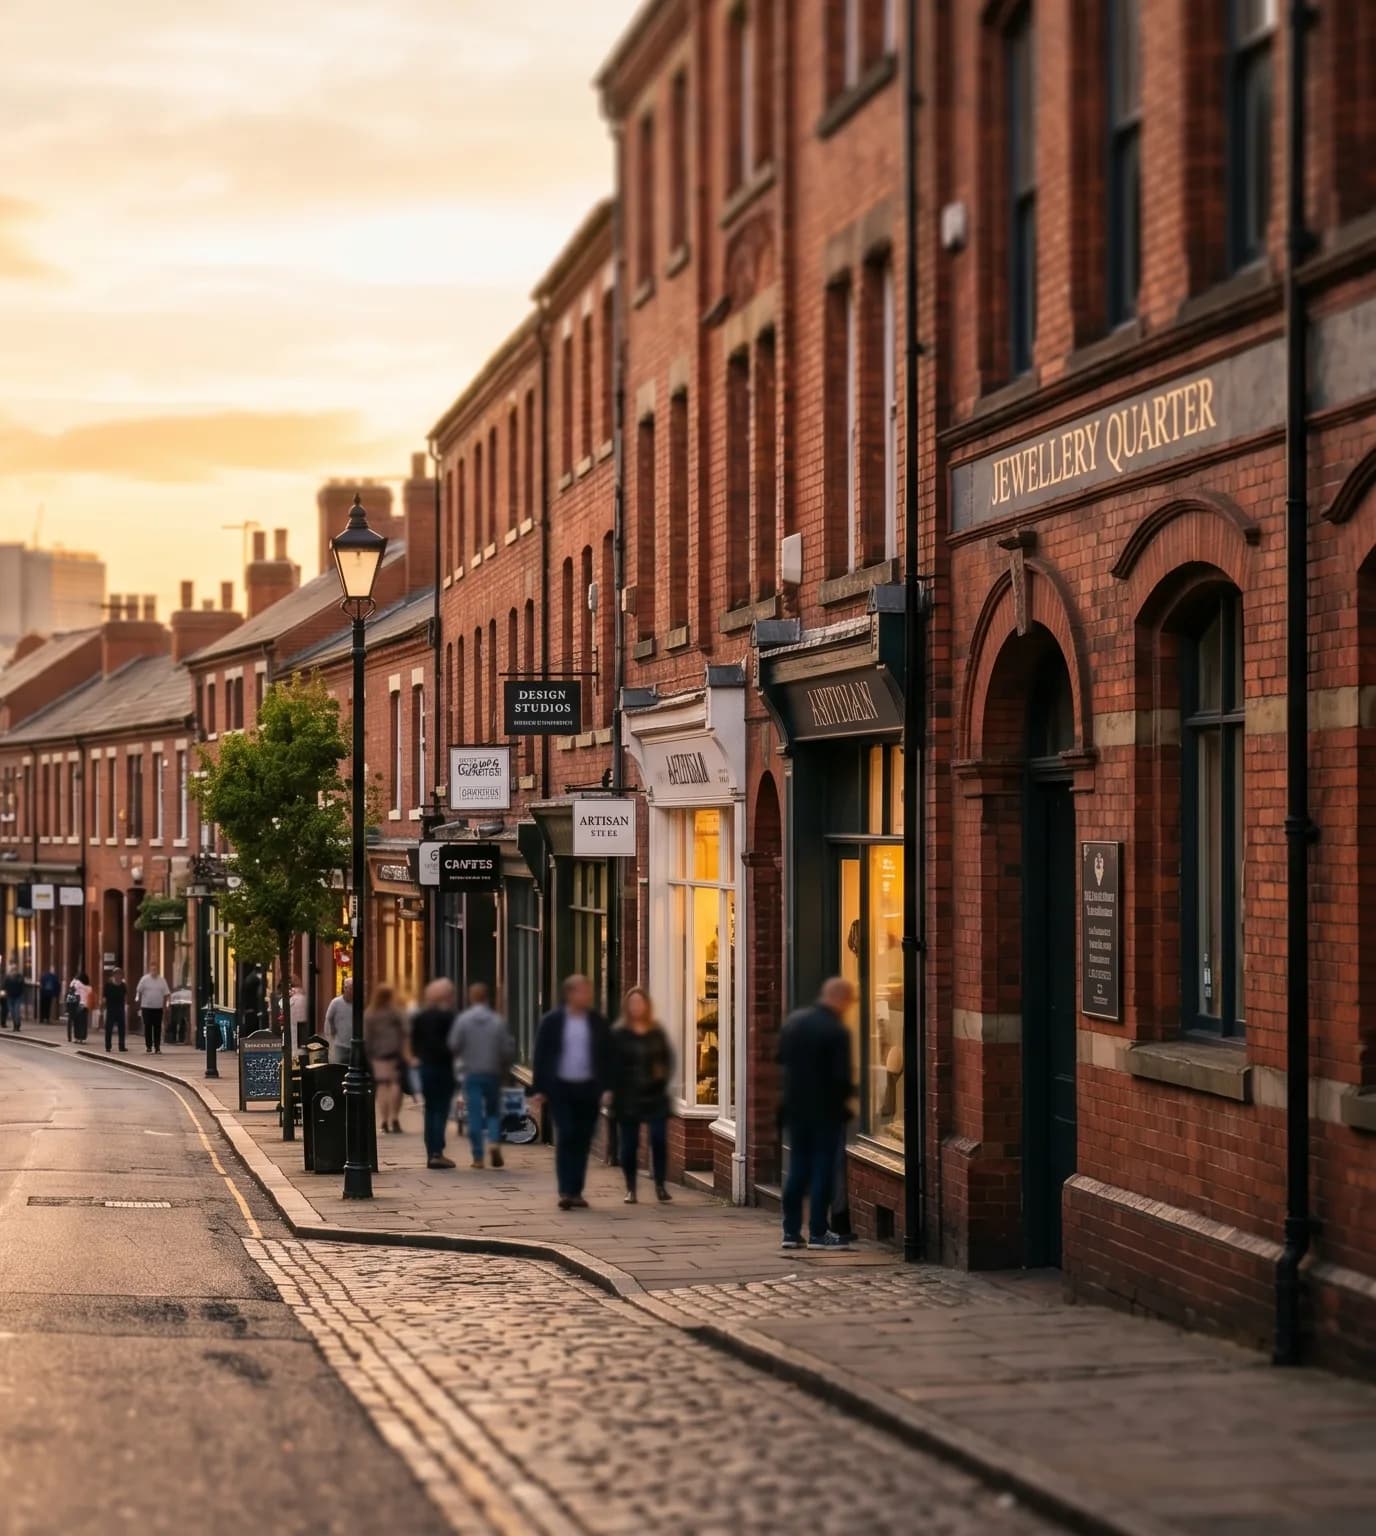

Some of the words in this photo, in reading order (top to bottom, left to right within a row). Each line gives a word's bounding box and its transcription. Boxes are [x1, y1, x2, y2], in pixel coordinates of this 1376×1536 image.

[991, 420, 1100, 506] JEWELLERY
[1106, 377, 1216, 473] QUARTER
[518, 690, 567, 700] DESIGN
[514, 703, 572, 713] STUDIOS
[579, 815, 629, 826] ARTISAN
